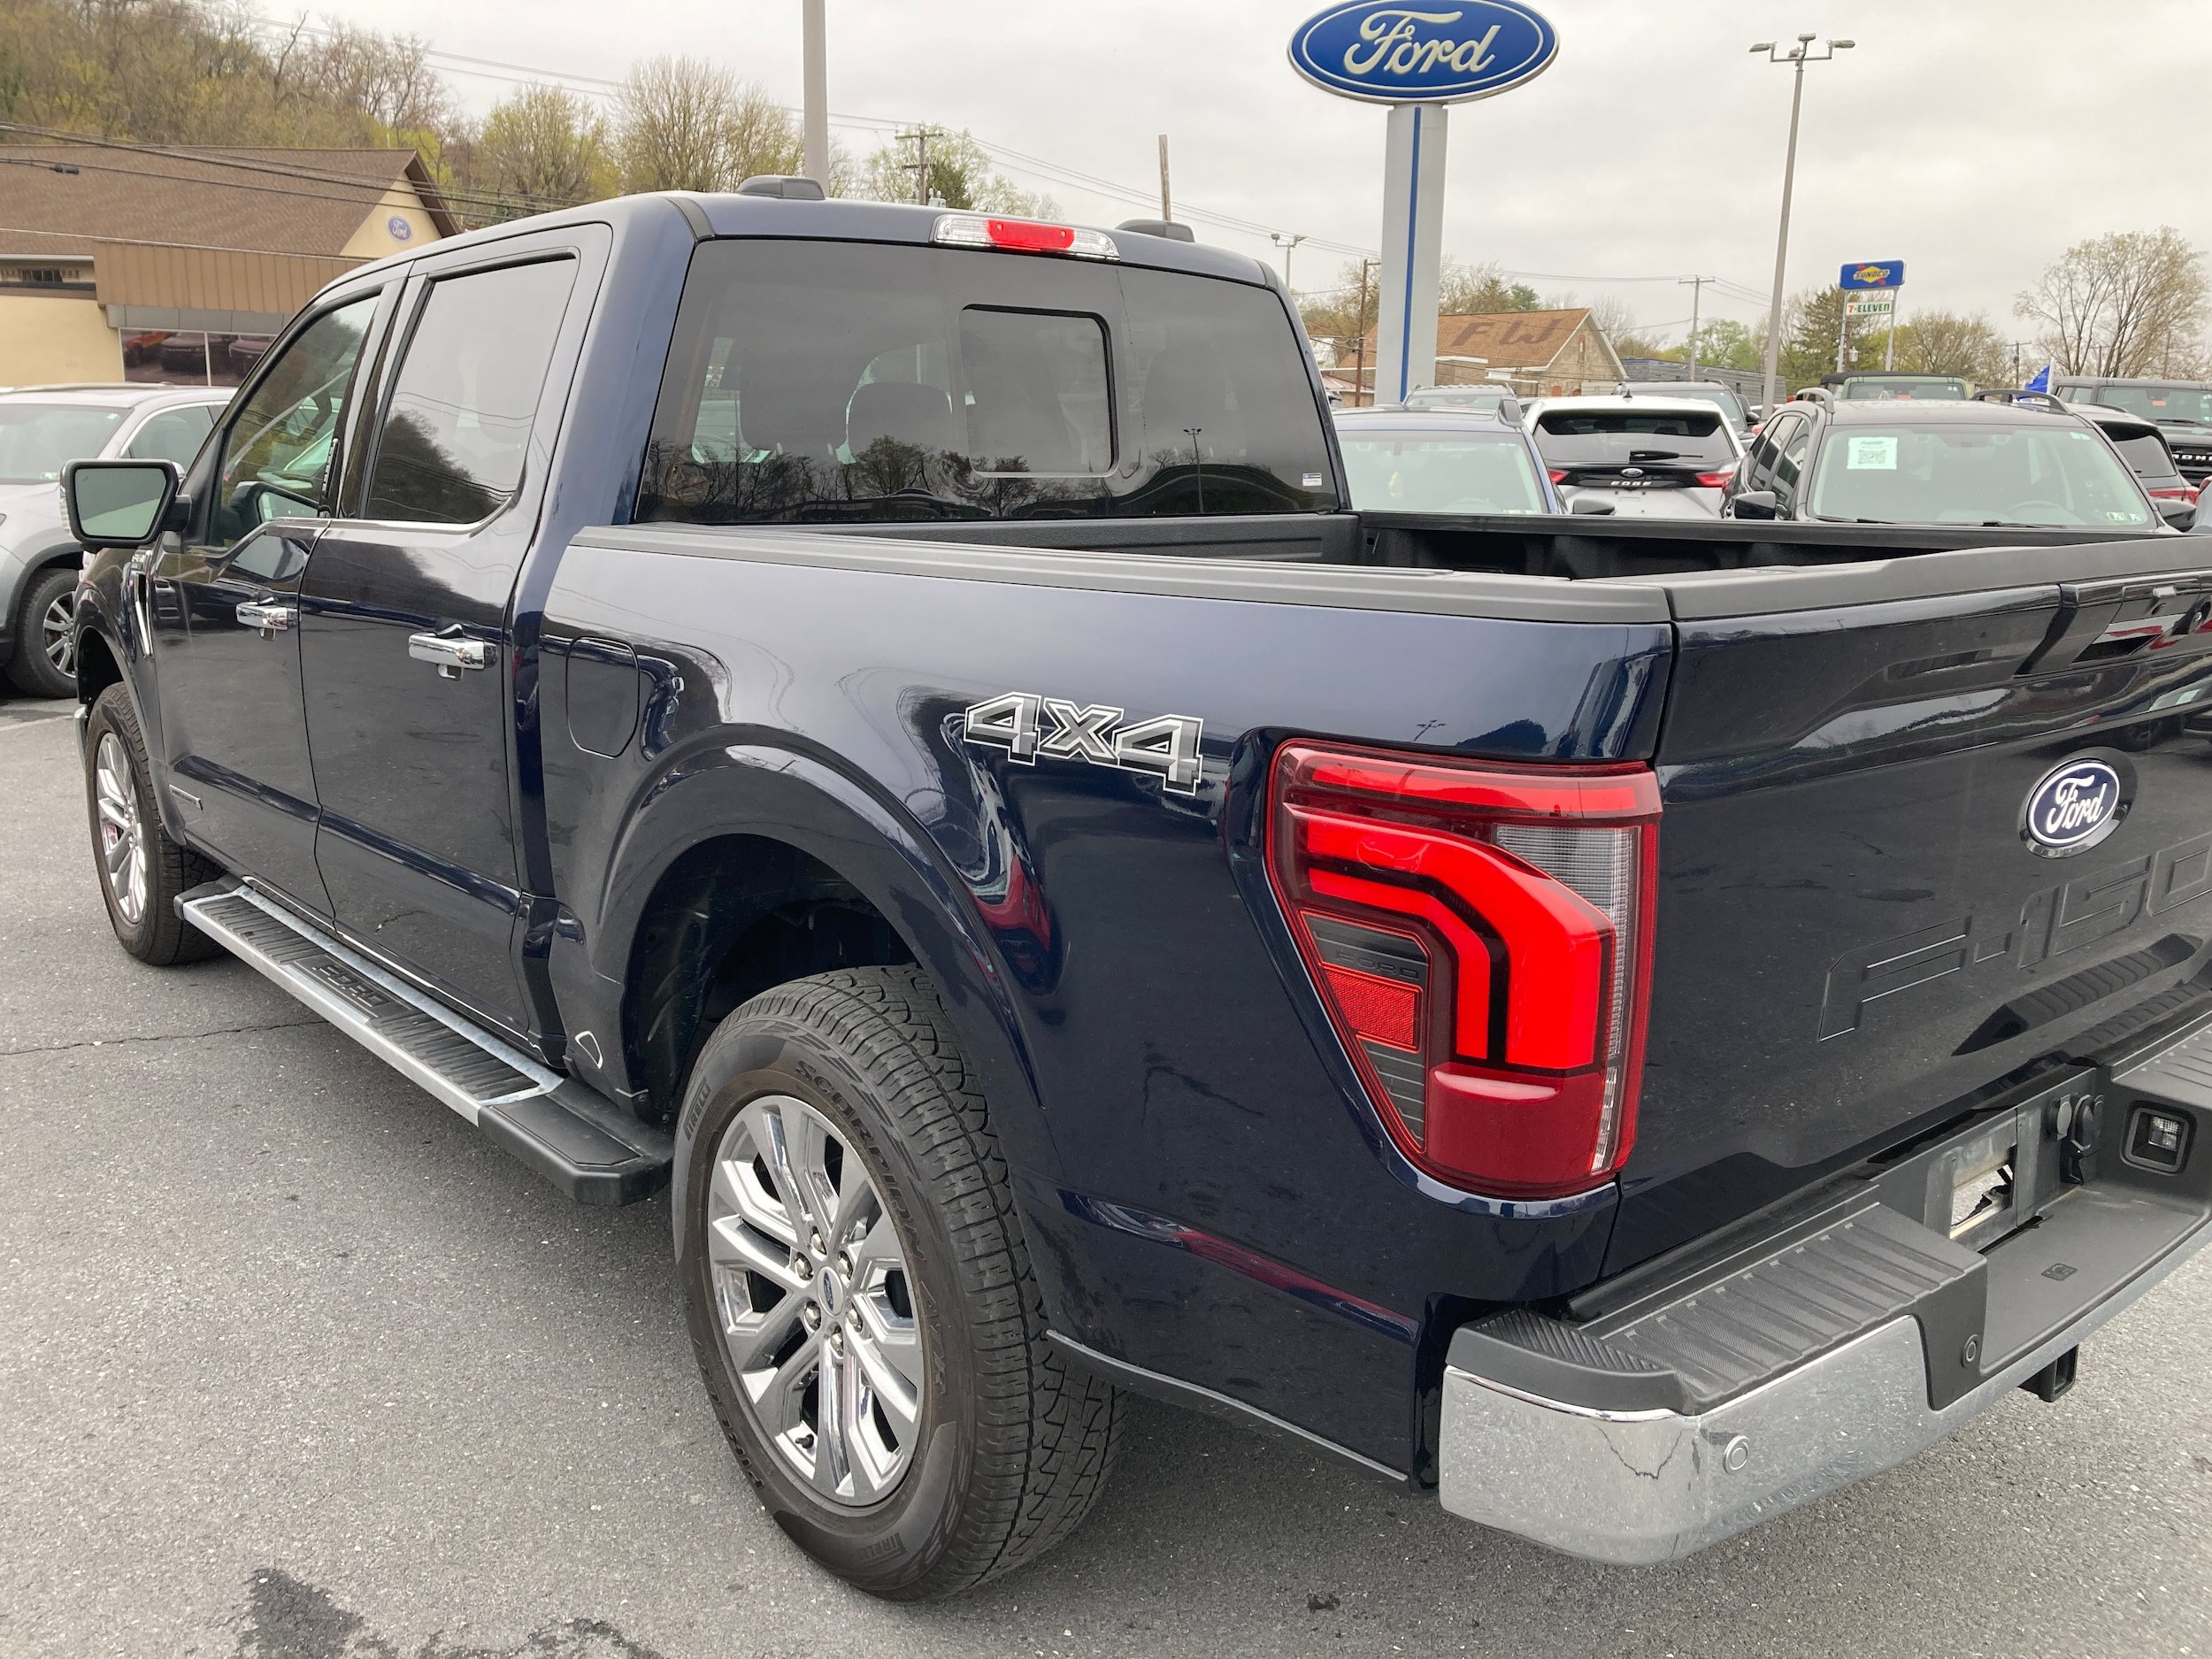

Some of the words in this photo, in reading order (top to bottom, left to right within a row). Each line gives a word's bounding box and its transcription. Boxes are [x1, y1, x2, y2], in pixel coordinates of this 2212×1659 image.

[1344, 10, 1502, 74] Ford
[1854, 269, 1889, 279] SUNOCO
[2046, 774, 2108, 834] Ford
[311, 964, 390, 1007] FORD
[683, 1076, 711, 1141] PIRELLI
[795, 1060, 926, 1263] SCORPION
